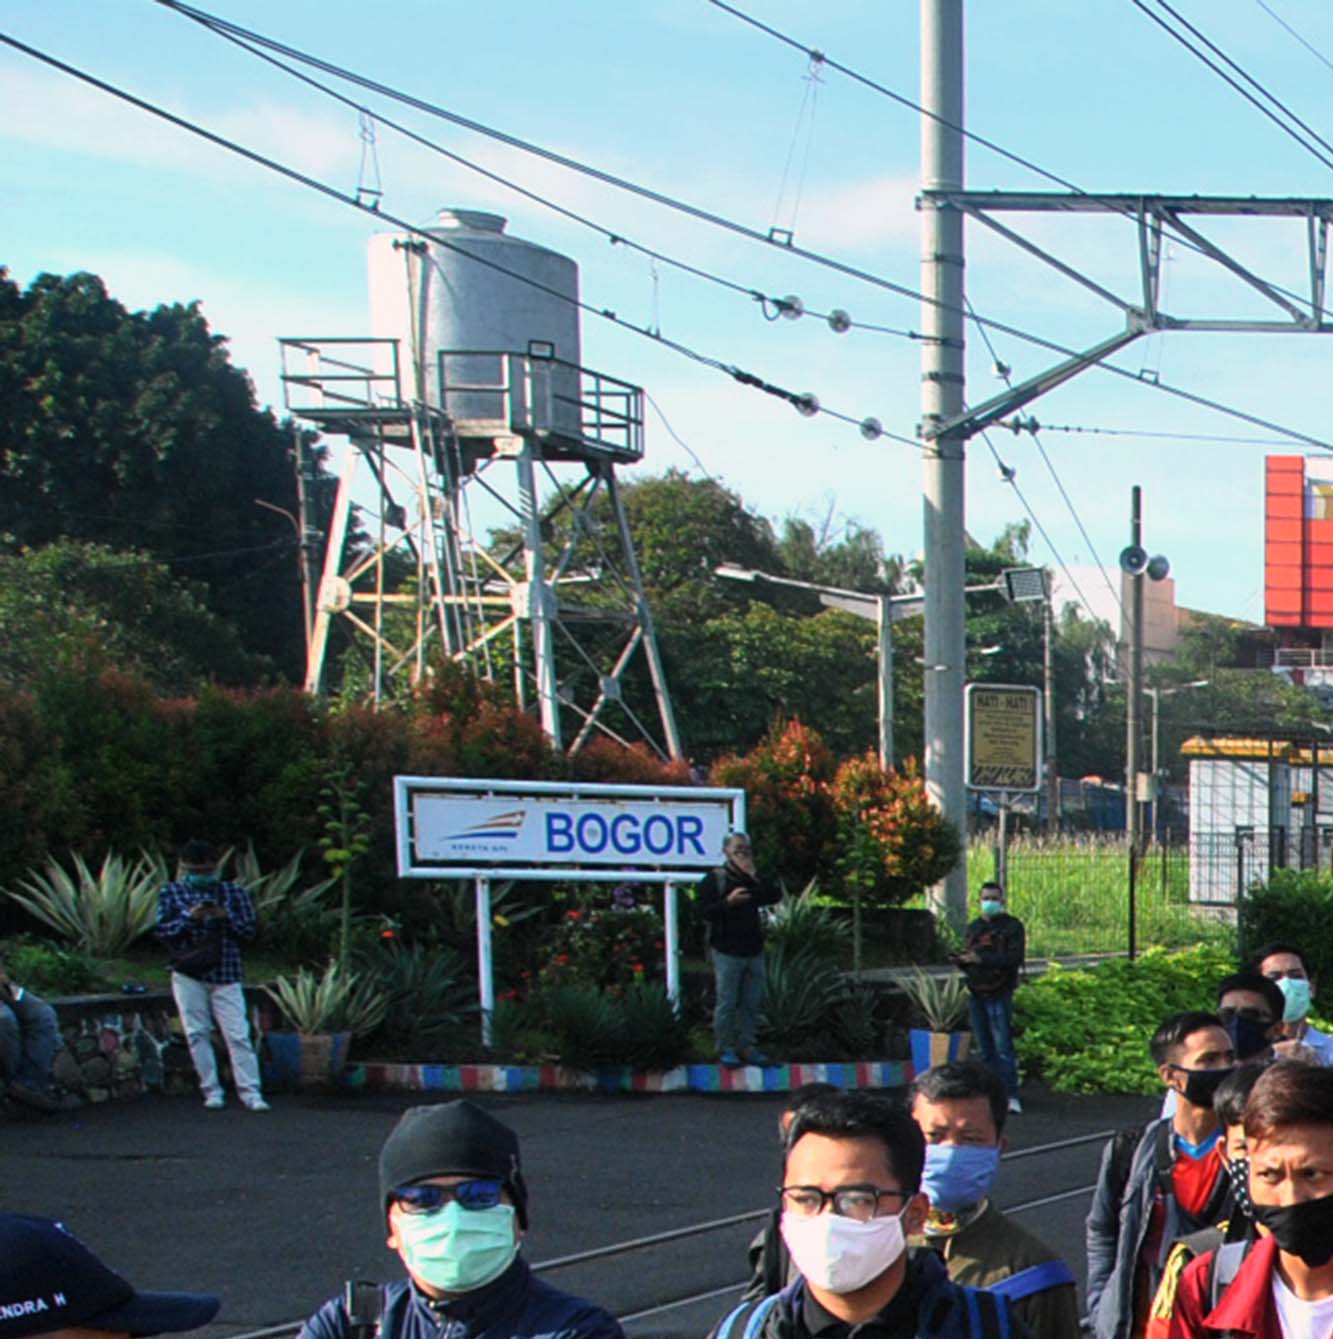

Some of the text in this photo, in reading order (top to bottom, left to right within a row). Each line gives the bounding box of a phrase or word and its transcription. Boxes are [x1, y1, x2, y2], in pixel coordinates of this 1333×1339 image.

[545, 811, 706, 855] BOGOR
[0, 1291, 67, 1320] NDRA H
